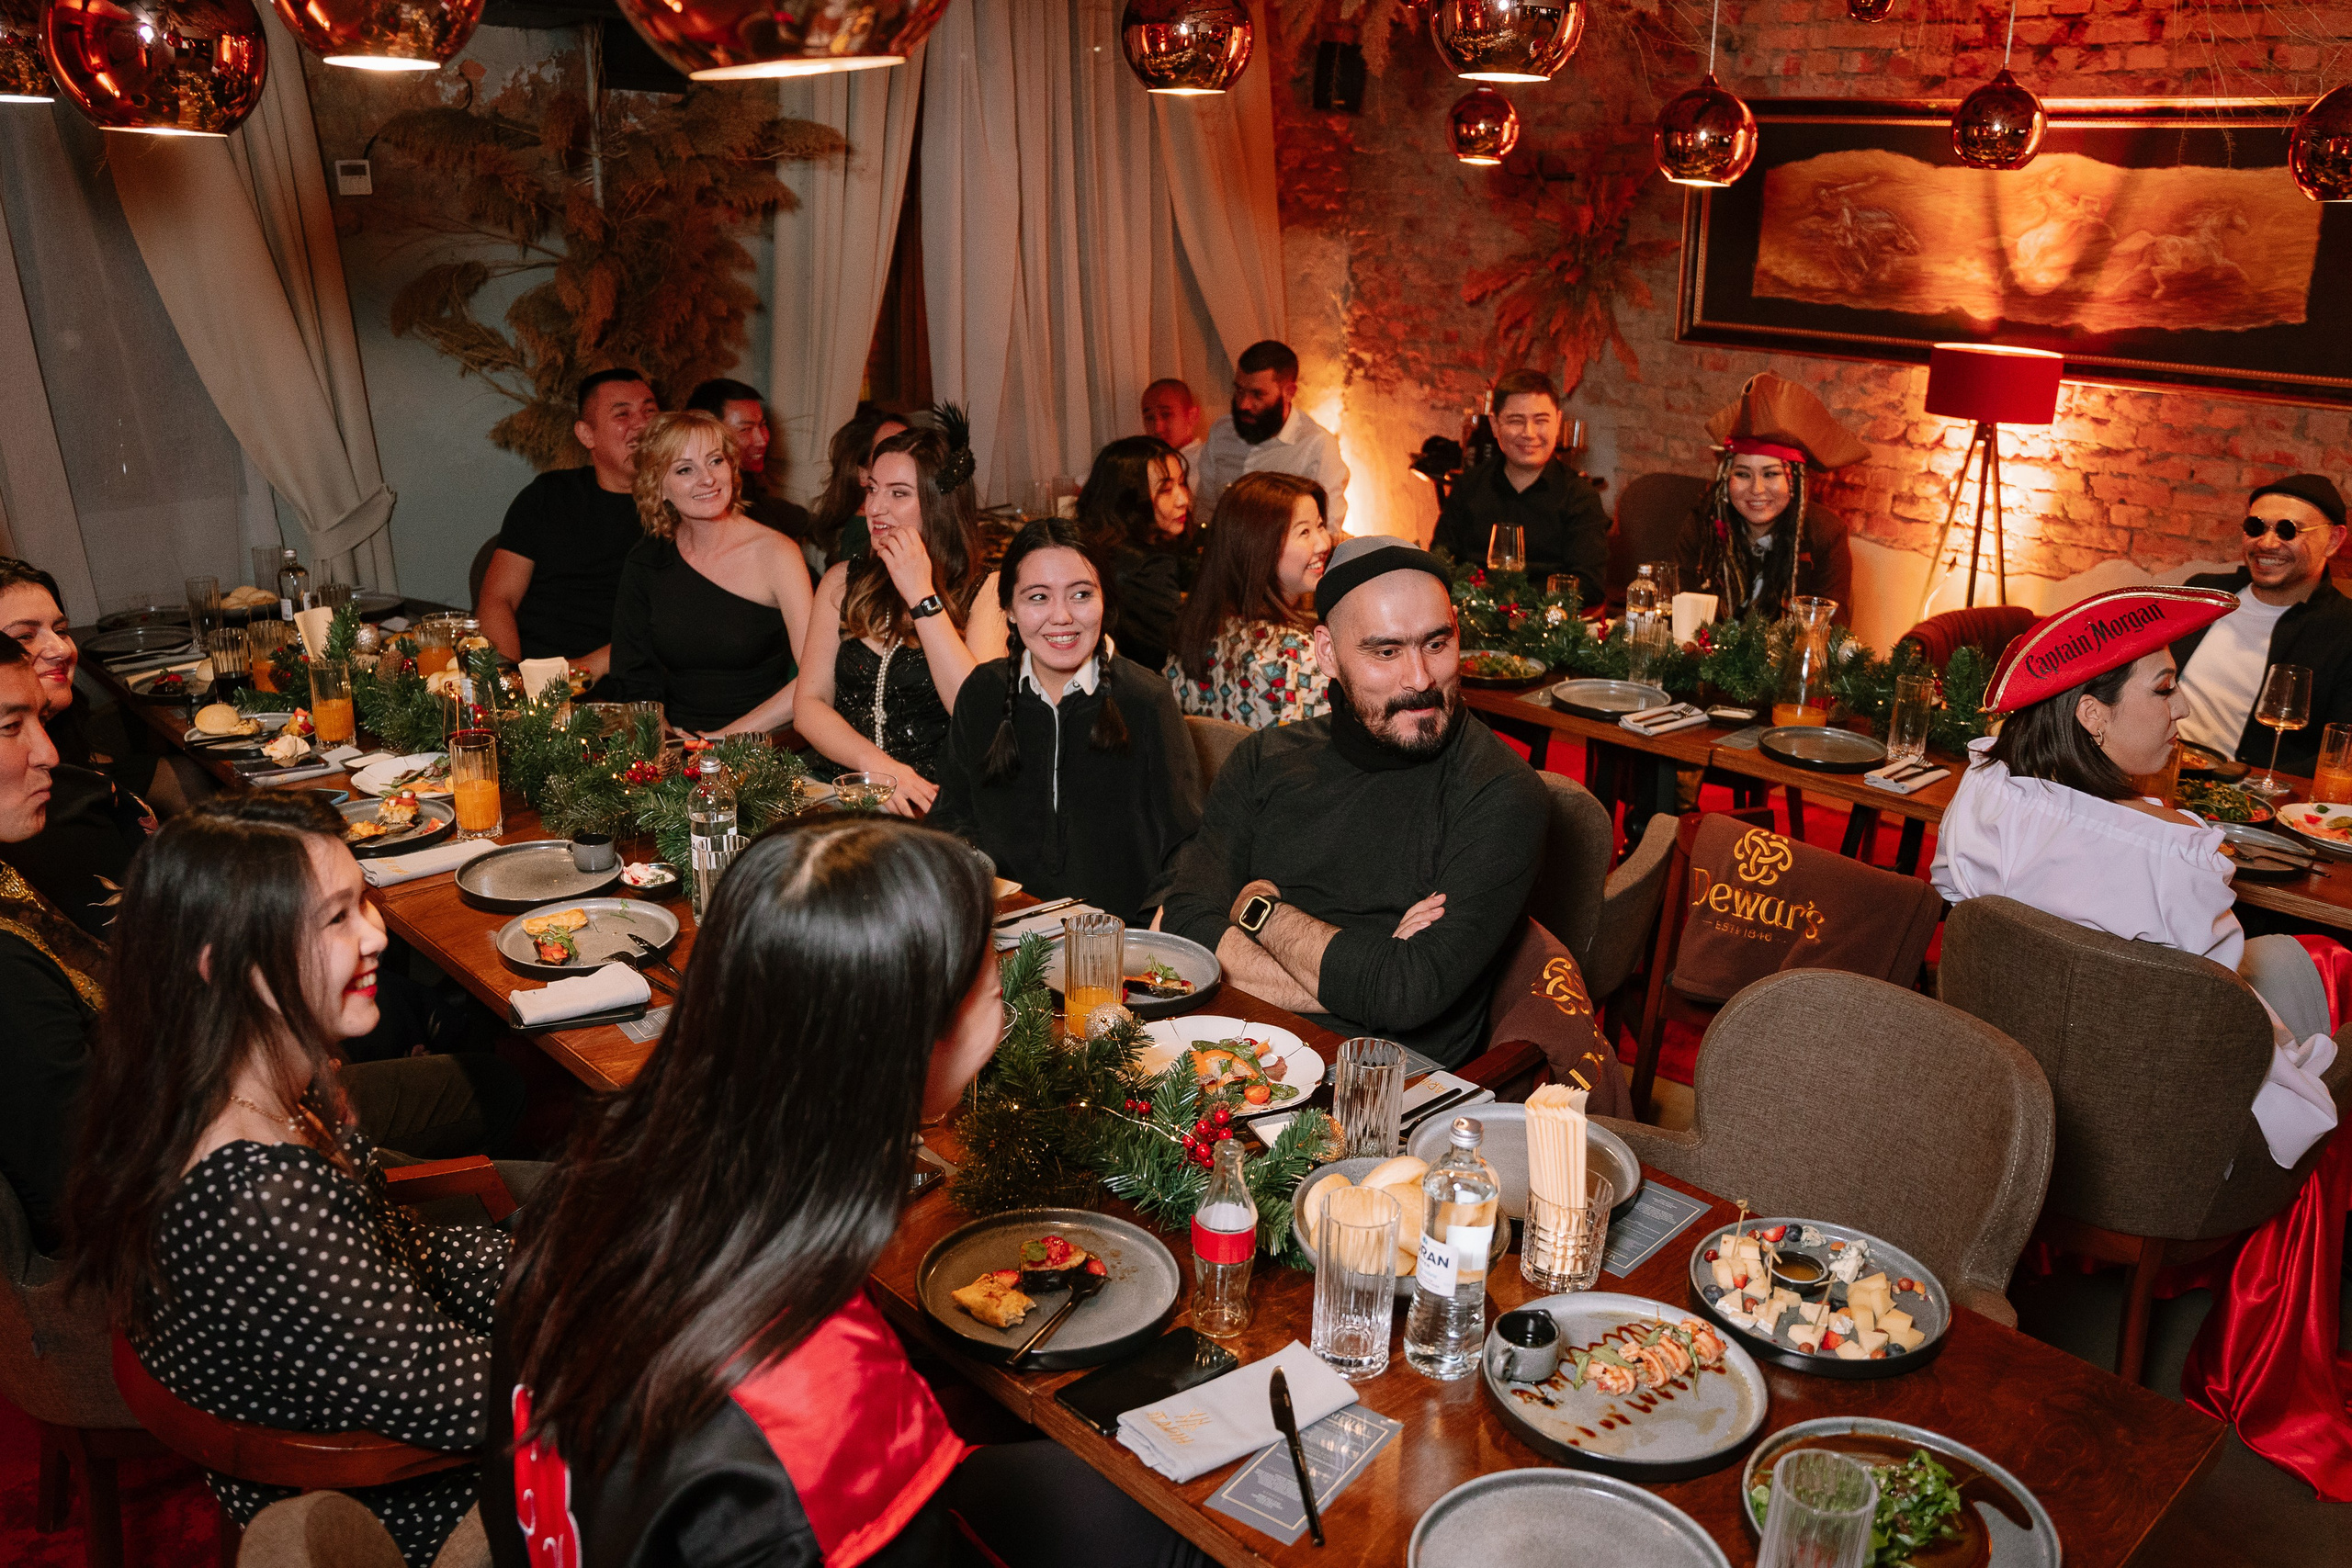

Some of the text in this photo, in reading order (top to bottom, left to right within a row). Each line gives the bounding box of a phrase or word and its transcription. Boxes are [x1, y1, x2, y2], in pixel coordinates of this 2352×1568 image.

[2025, 602, 2165, 680] Captain Morgan
[1692, 867, 1825, 940] Dewar's
[1743, 928, 1772, 942] 1846
[1419, 1245, 1450, 1269] RAN
